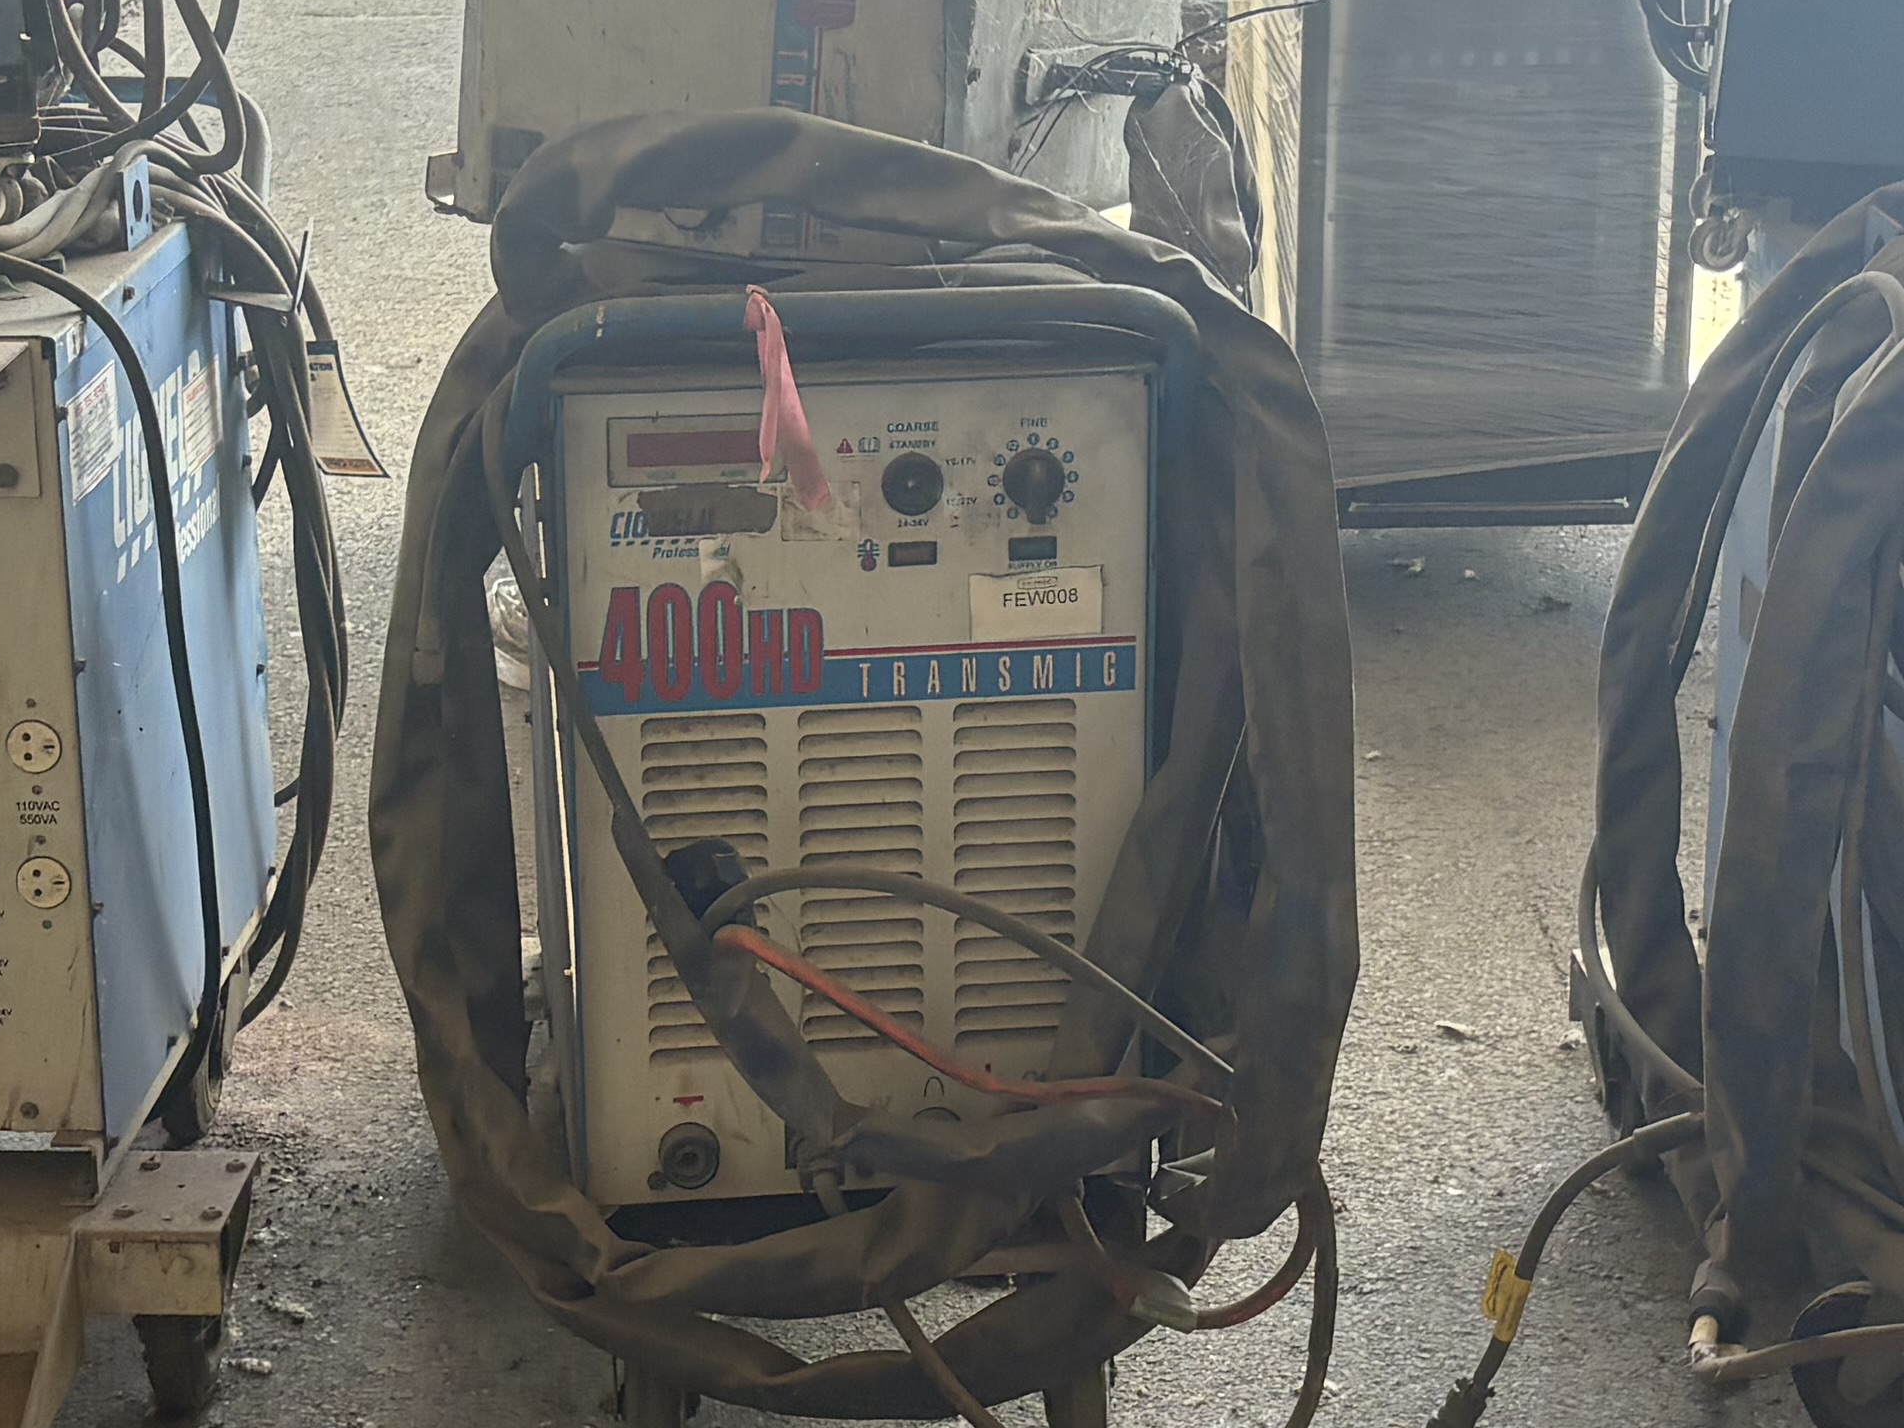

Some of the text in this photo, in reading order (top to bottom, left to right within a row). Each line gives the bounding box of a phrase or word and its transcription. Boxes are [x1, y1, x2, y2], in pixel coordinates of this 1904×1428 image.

[886, 421, 940, 433] COARSE
[1019, 417, 1049, 429] FINE
[1002, 587, 1079, 608] FEW008
[597, 581, 824, 702] 400HD
[859, 651, 1118, 698] TRANSMIG
[15, 800, 61, 813] 110VAC
[19, 814, 58, 825] 550VA
